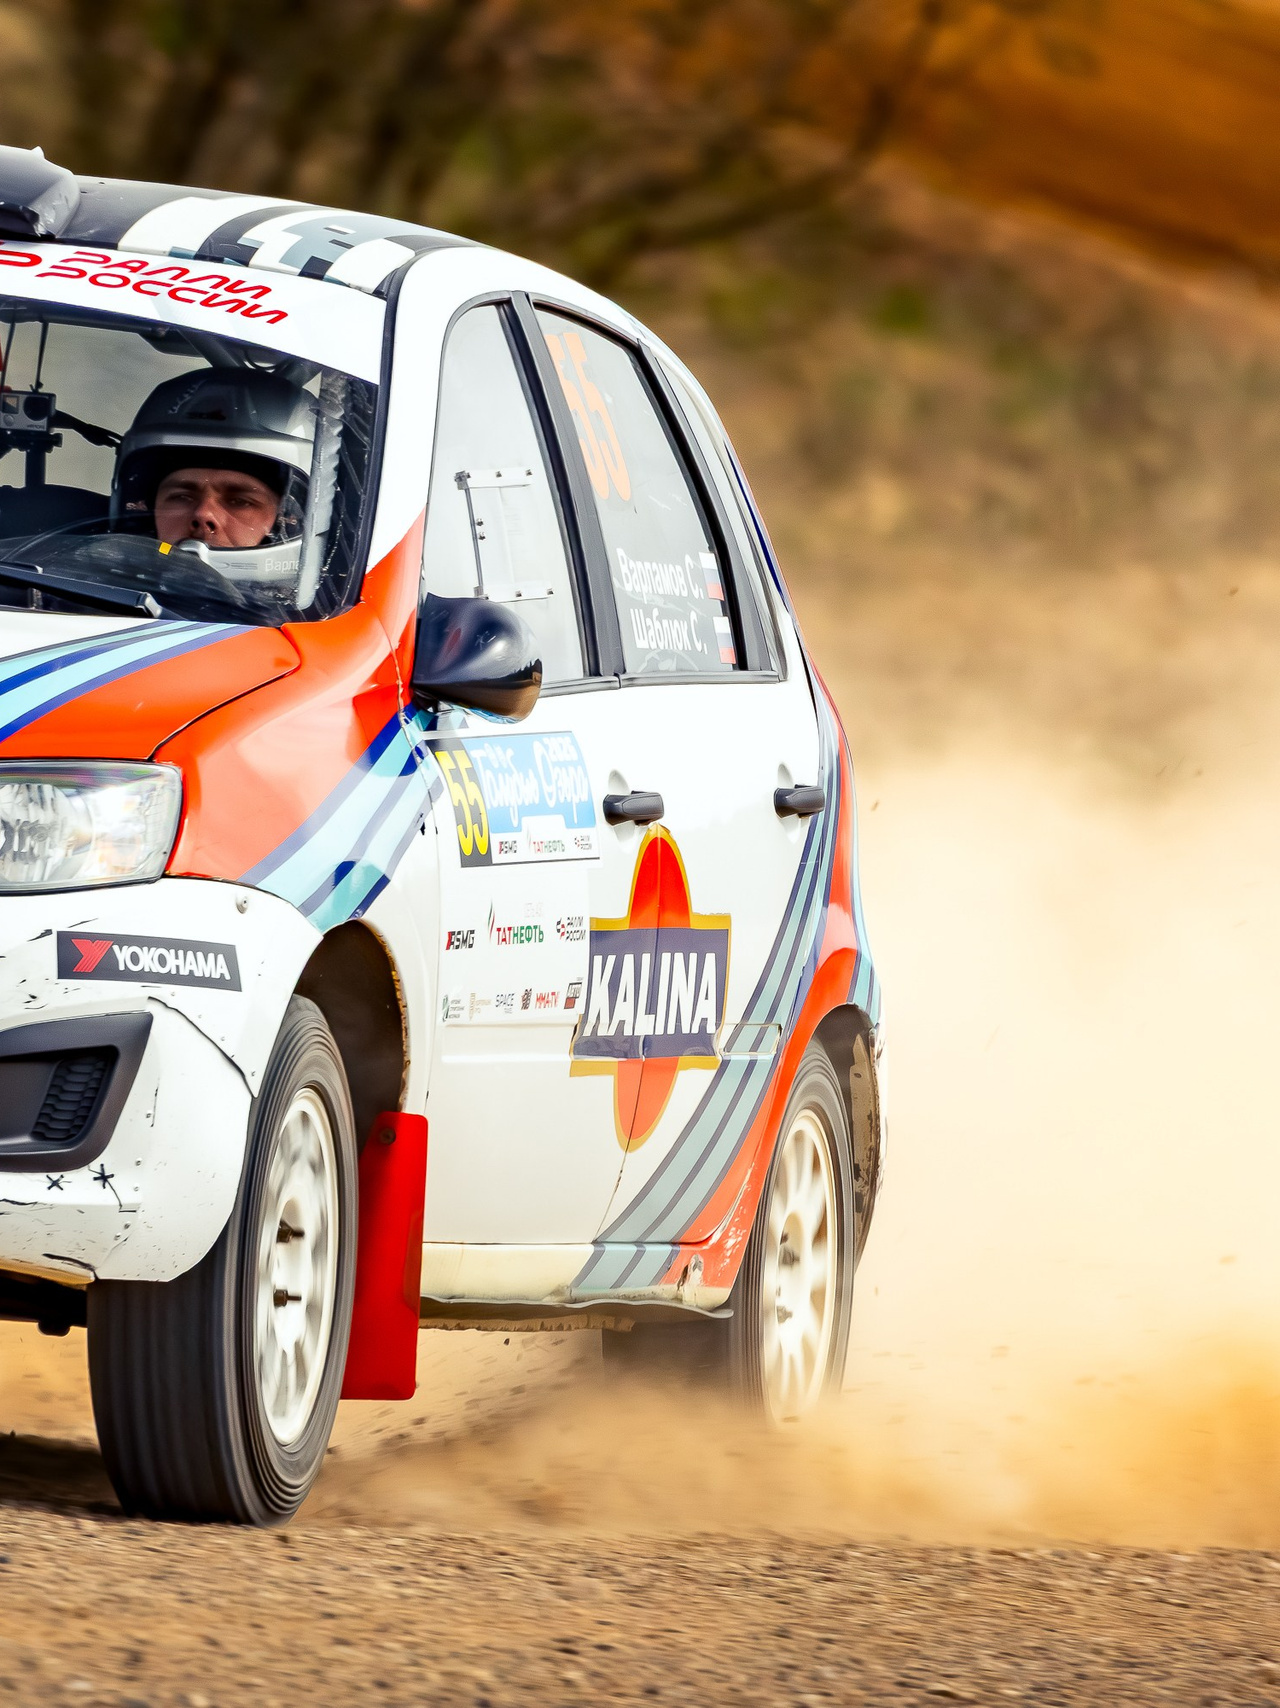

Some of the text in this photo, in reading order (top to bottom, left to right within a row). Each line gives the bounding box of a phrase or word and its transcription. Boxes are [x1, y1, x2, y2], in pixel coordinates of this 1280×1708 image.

[35, 265, 289, 325] РОССИИ
[59, 251, 273, 300] РАЛЛИ
[545, 332, 631, 501] 55
[616, 548, 705, 605] Варламов С.
[630, 608, 708, 655] Шаблюк С.
[435, 750, 489, 857] 55
[111, 944, 232, 981] YOKOHAMA
[496, 925, 545, 946] ТАТНЕФТЬ
[581, 952, 717, 1037] KALINA
